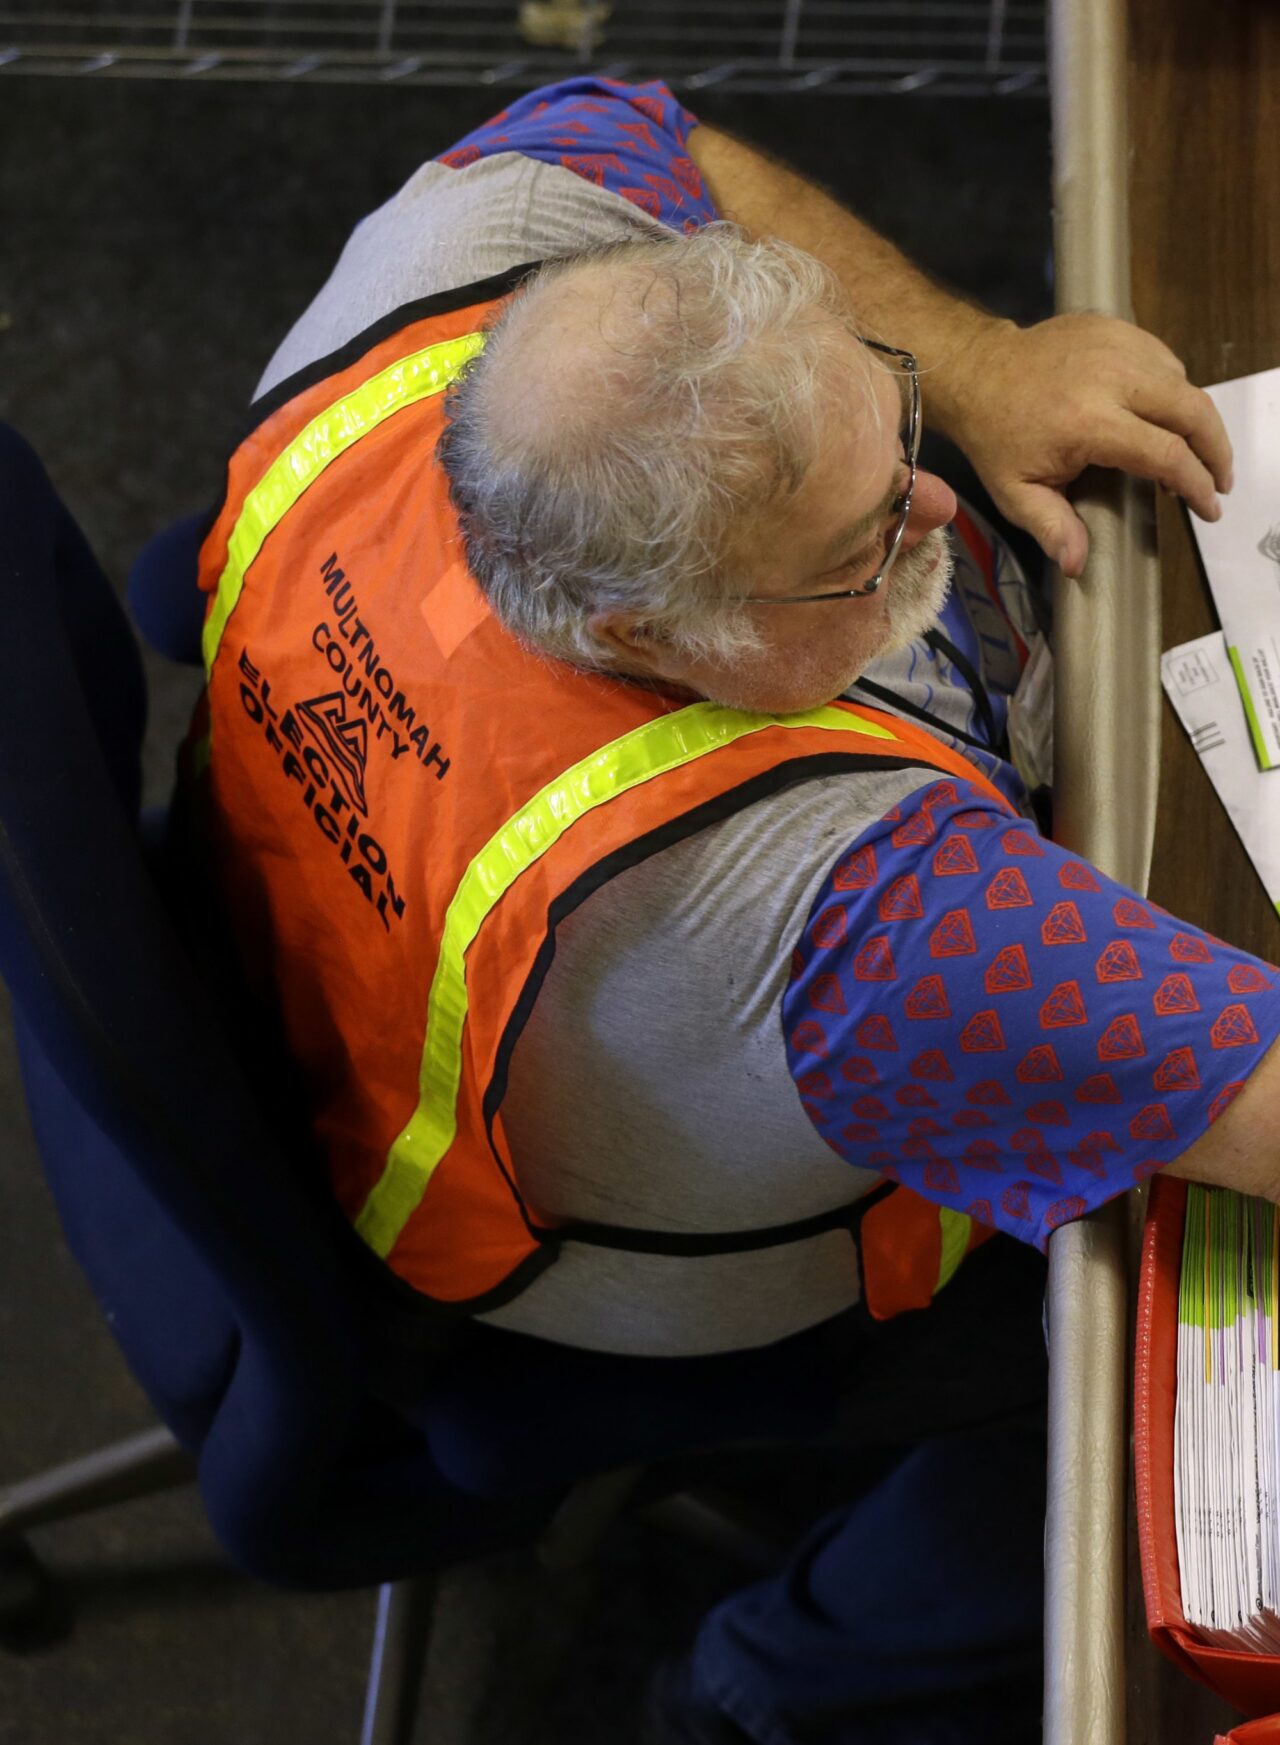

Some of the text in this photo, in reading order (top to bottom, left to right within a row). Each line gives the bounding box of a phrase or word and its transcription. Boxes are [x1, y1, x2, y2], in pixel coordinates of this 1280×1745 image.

[239, 647, 406, 920] ELECTION
[312, 623, 409, 760] COUNTY
[320, 552, 451, 781] MULTNOMAH
[239, 683, 391, 933] OFFICIAL
